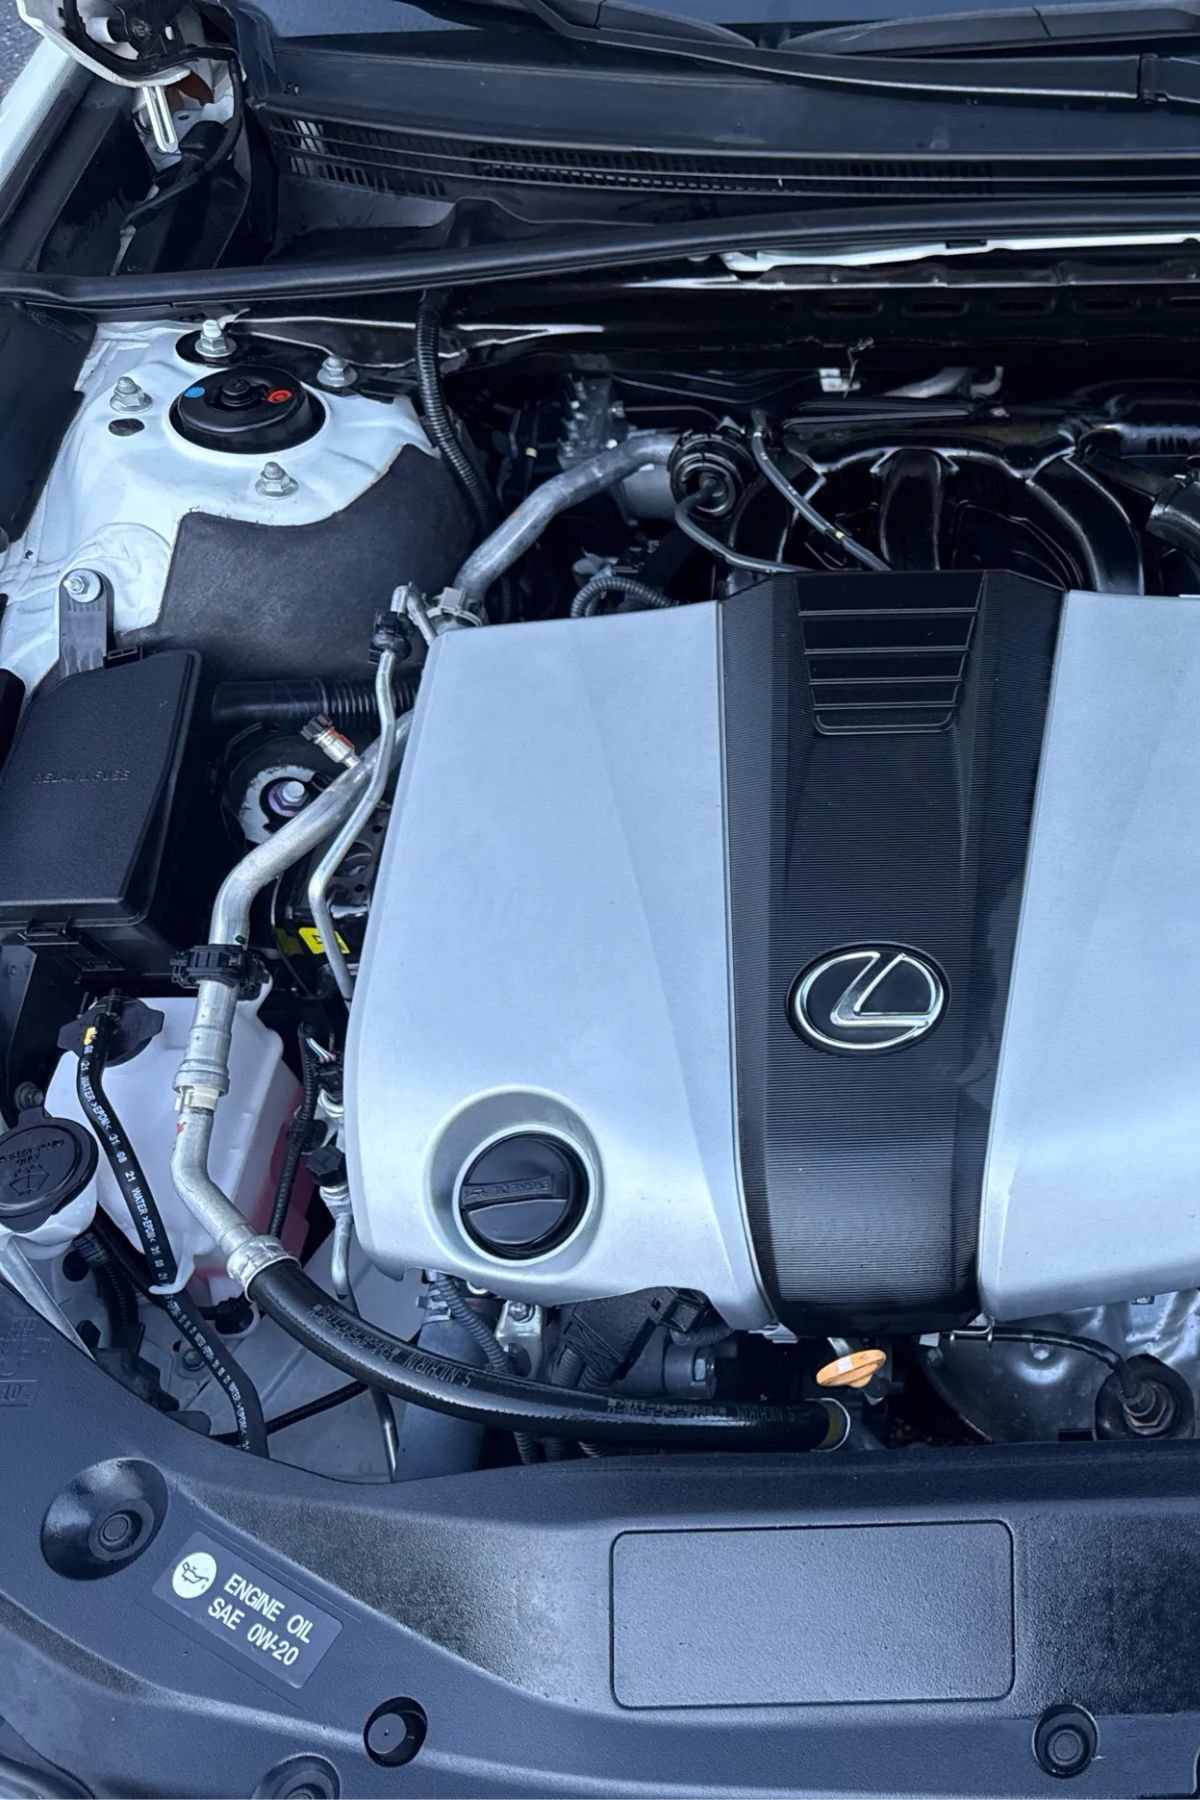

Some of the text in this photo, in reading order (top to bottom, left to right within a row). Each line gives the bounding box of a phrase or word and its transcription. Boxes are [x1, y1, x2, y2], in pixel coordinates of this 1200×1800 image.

[81, 1075, 96, 1102] WATER
[109, 1134, 120, 1145] 31
[116, 1151, 127, 1163] 08
[125, 1170, 136, 1182] 21
[131, 1186, 148, 1218] WATER
[208, 1597, 299, 1666] SAE 0W-20
[223, 1573, 313, 1644] ENGINE OIL
